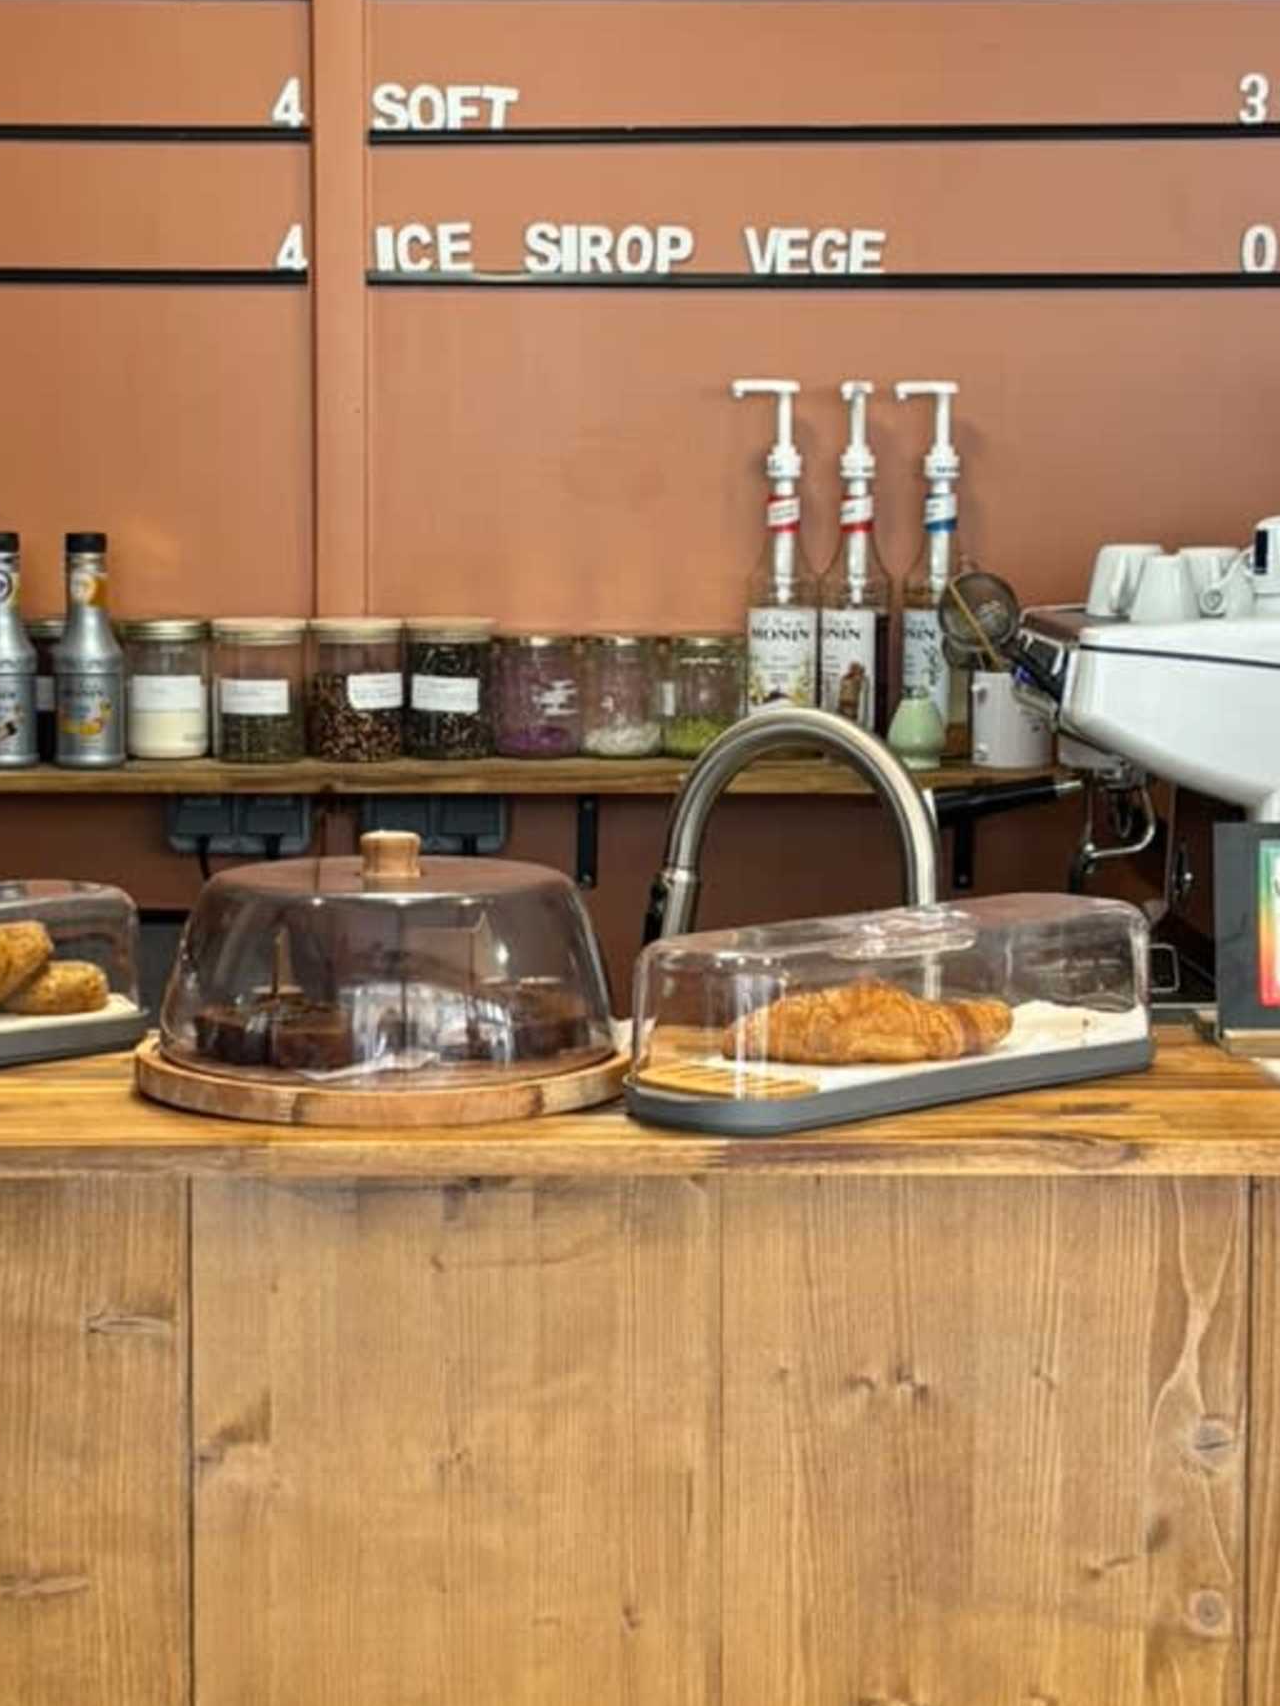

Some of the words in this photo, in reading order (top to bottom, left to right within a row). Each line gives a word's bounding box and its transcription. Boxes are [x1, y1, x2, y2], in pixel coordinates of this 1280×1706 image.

[265, 77, 306, 127] 4
[371, 84, 519, 130] SOFT
[1237, 72, 1270, 124] 3
[270, 224, 309, 271] 4
[374, 223, 474, 274] ICE
[523, 223, 695, 275] SIROP
[743, 227, 887, 275] VEGE
[1239, 225, 1278, 274] 0
